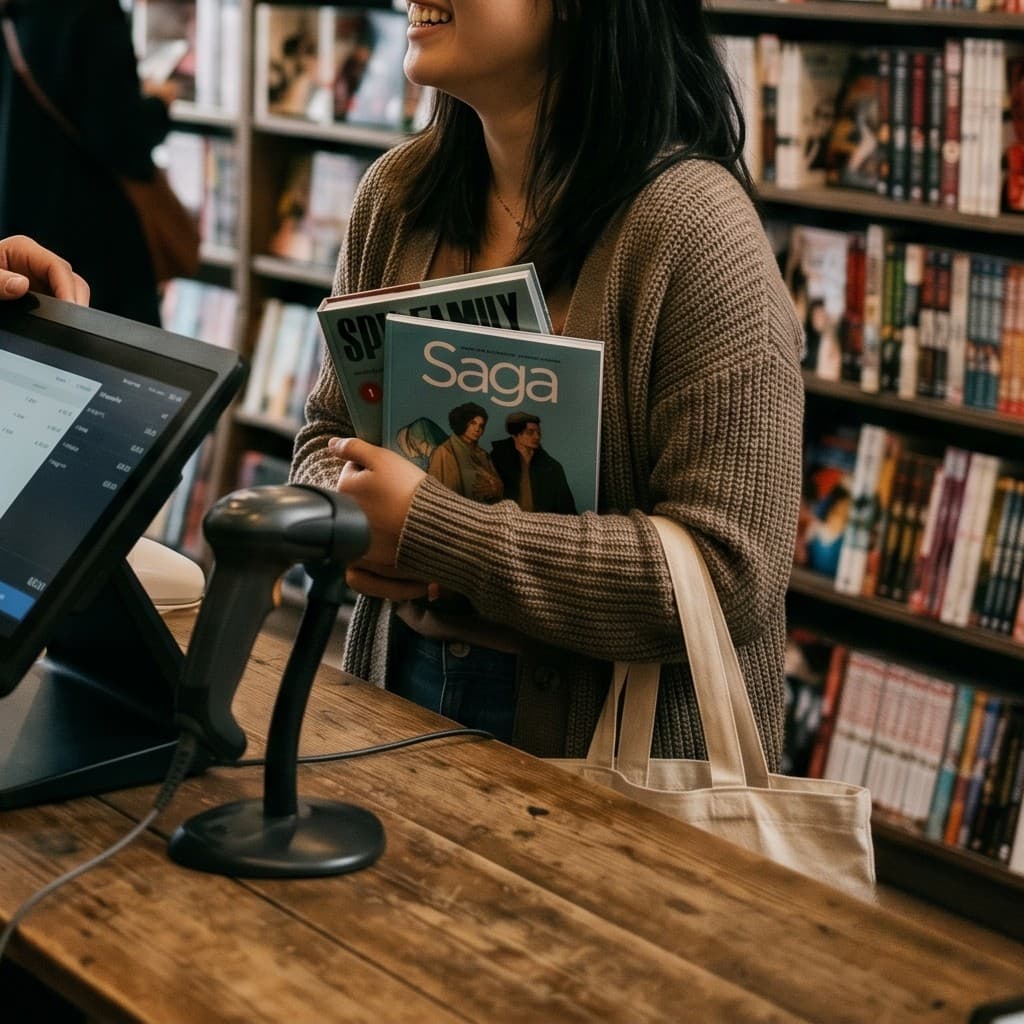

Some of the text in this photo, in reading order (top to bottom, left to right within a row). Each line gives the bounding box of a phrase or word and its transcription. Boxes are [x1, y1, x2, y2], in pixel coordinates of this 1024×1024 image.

[337, 292, 520, 362] SP MILY
[422, 340, 558, 407] Saga
